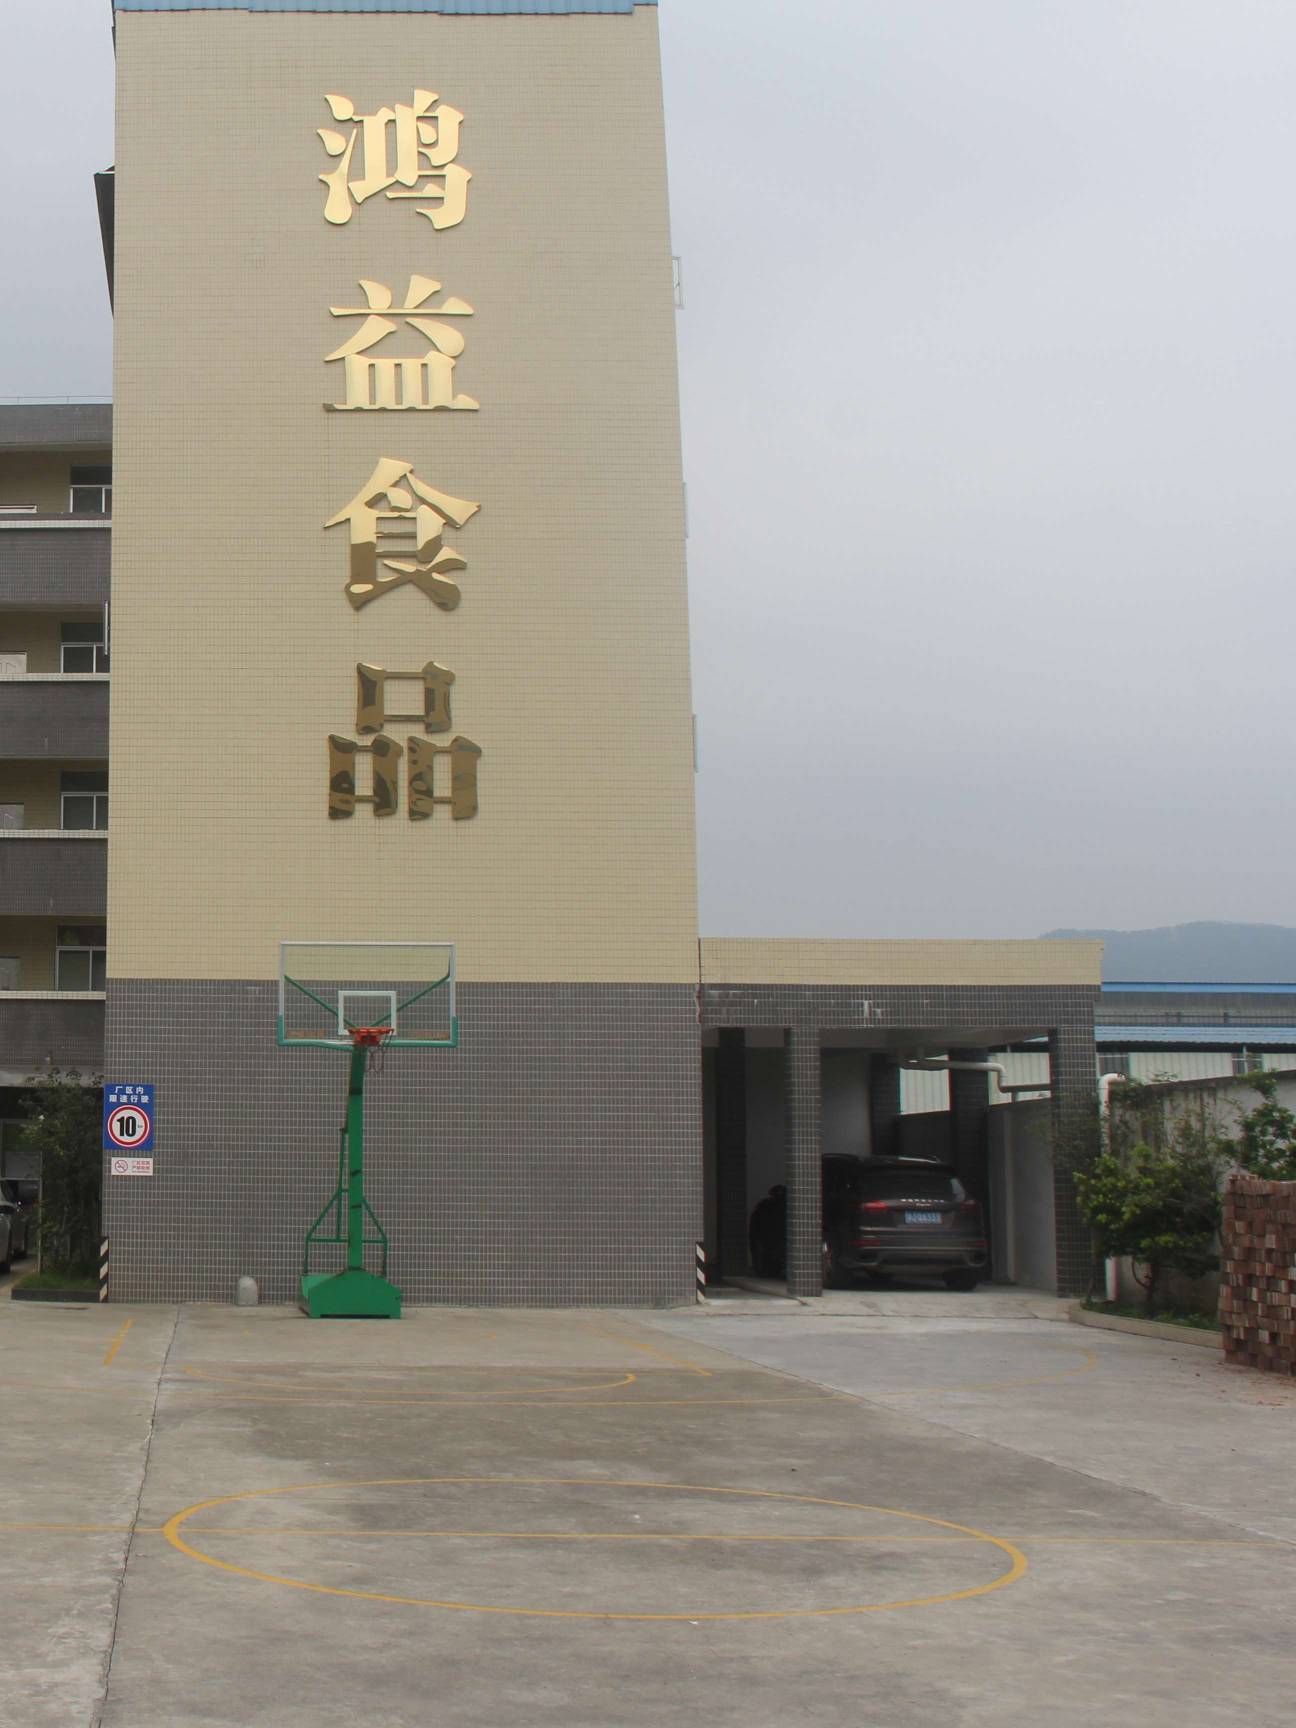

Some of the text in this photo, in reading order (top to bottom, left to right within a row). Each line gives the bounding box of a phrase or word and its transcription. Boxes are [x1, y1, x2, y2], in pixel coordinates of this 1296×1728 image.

[316, 89, 482, 821] 鸿益食品
[115, 1086, 144, 1095] 厂区内
[117, 1116, 136, 1137] 10
